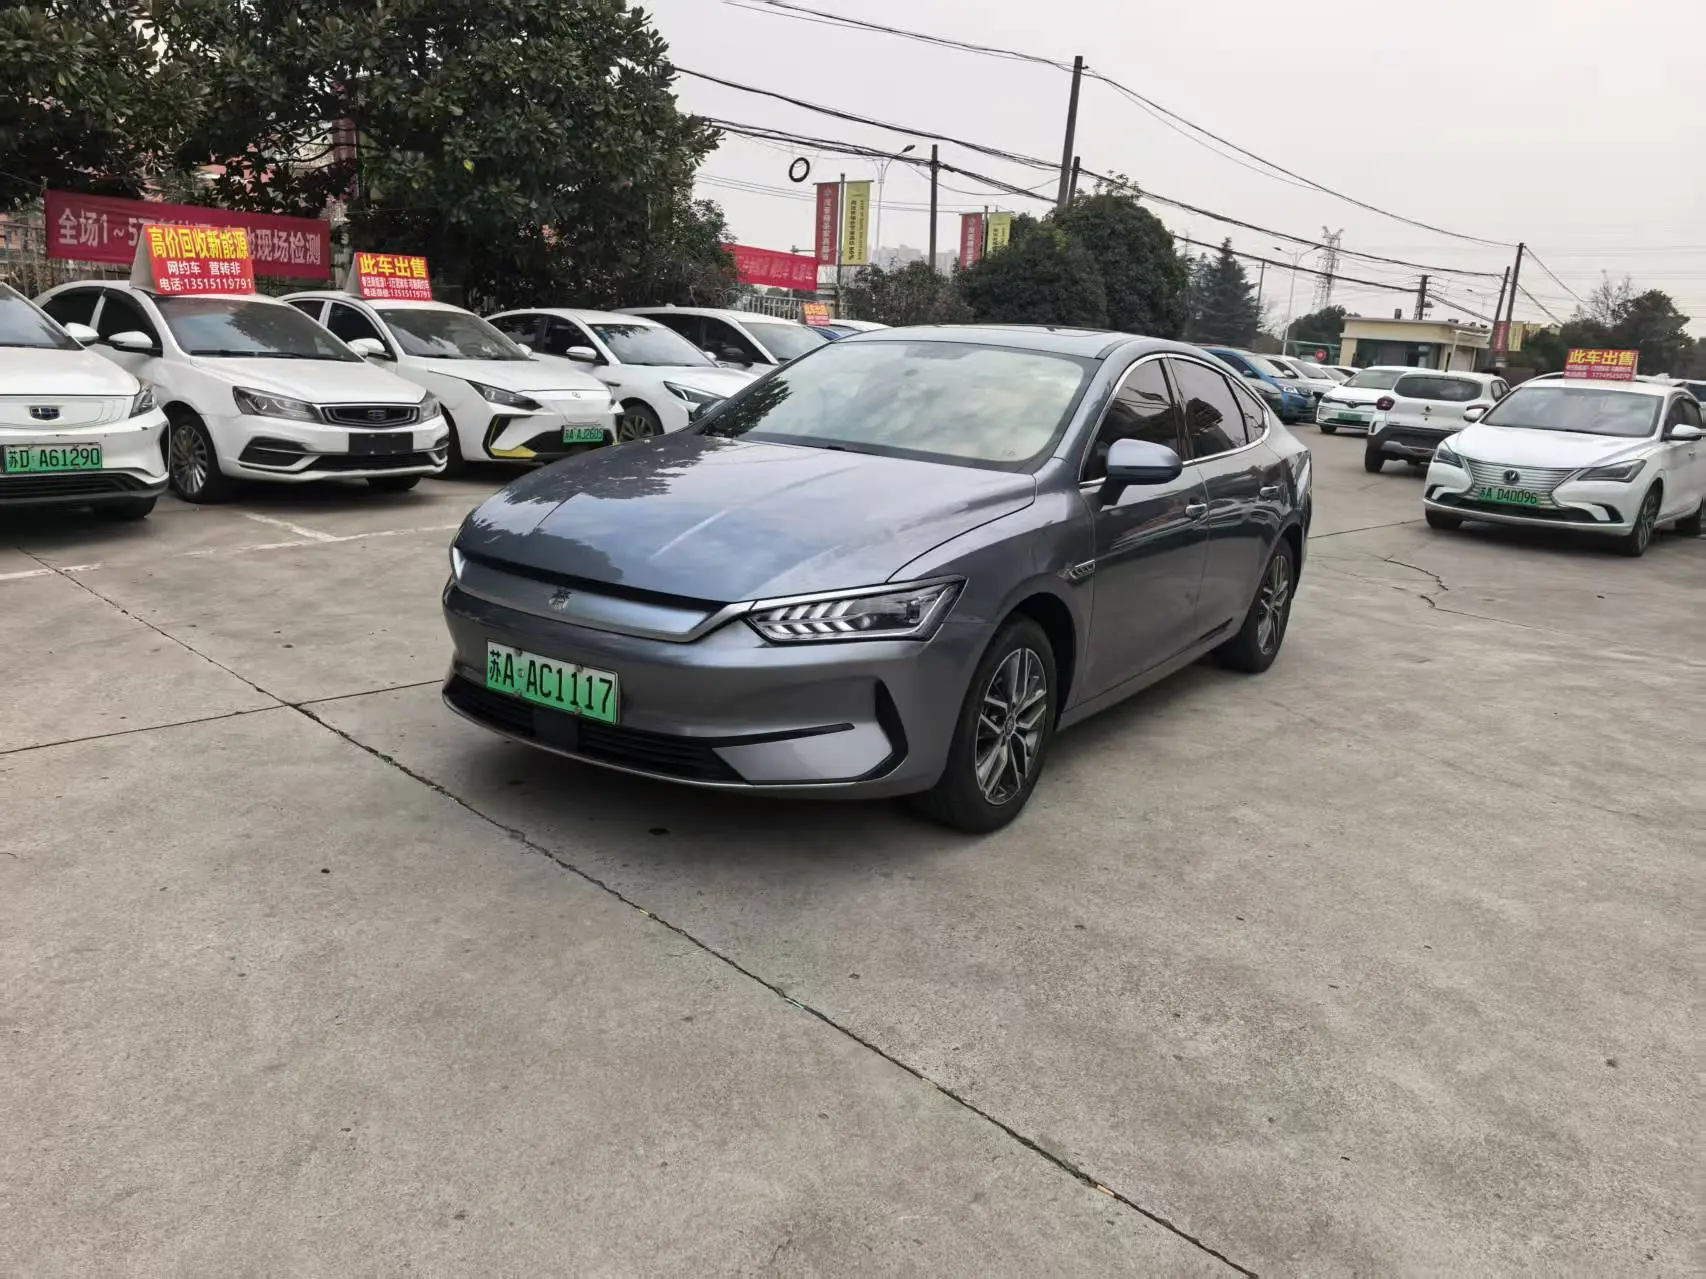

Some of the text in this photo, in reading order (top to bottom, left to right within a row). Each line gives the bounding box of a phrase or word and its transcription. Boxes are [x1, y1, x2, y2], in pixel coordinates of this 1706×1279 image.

[148, 226, 249, 259] 高价回收新能源
[167, 261, 241, 276] 网约车 营转非
[359, 253, 426, 279] 此车出售
[1568, 349, 1635, 366] 此车出售
[526, 659, 613, 715] AC1117
